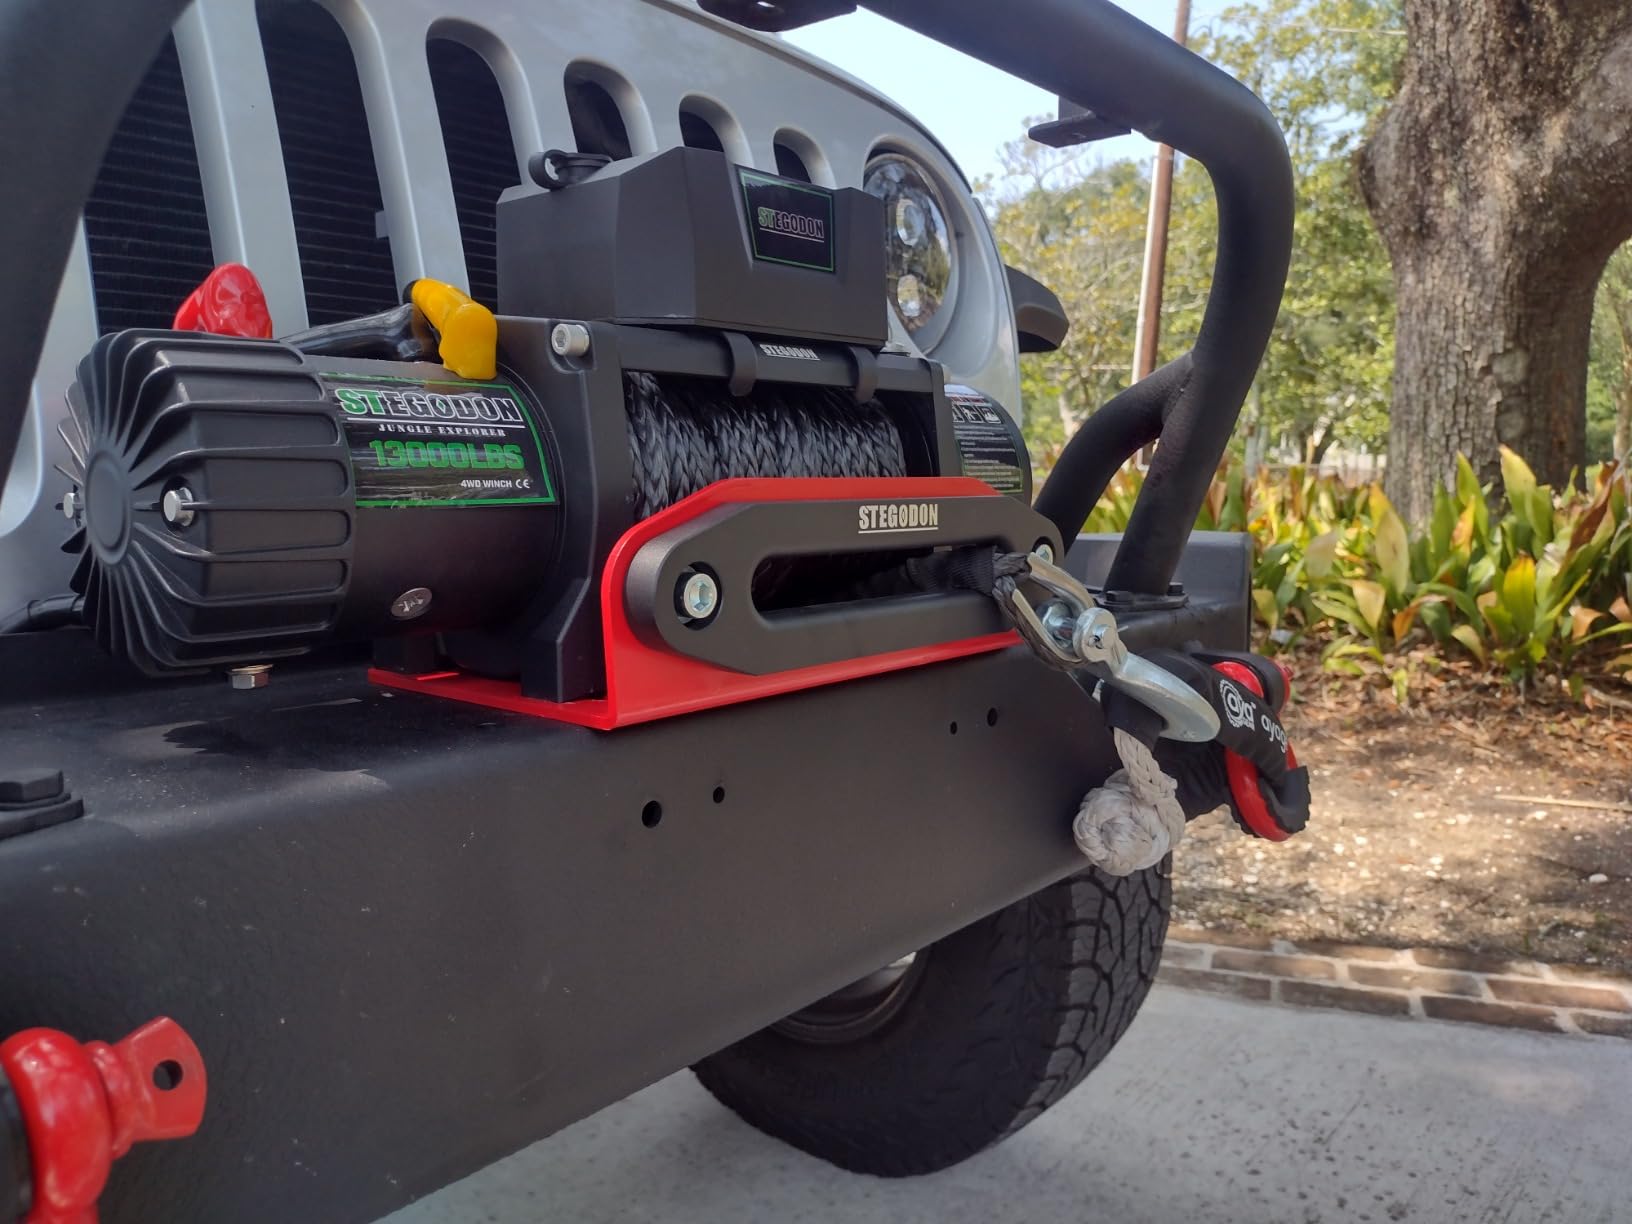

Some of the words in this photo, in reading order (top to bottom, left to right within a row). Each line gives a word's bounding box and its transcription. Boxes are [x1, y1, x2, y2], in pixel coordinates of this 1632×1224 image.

[757, 206, 825, 239] STEGODON
[759, 343, 819, 359] STEGODON
[334, 388, 524, 422] STEGODON
[378, 424, 434, 434] JUNGLE
[438, 426, 506, 437] EXPLORER
[369, 439, 525, 469] 13000LBS
[460, 479, 481, 488] 4WD
[482, 480, 512, 488] WINCH
[858, 503, 939, 530] STEGODON
